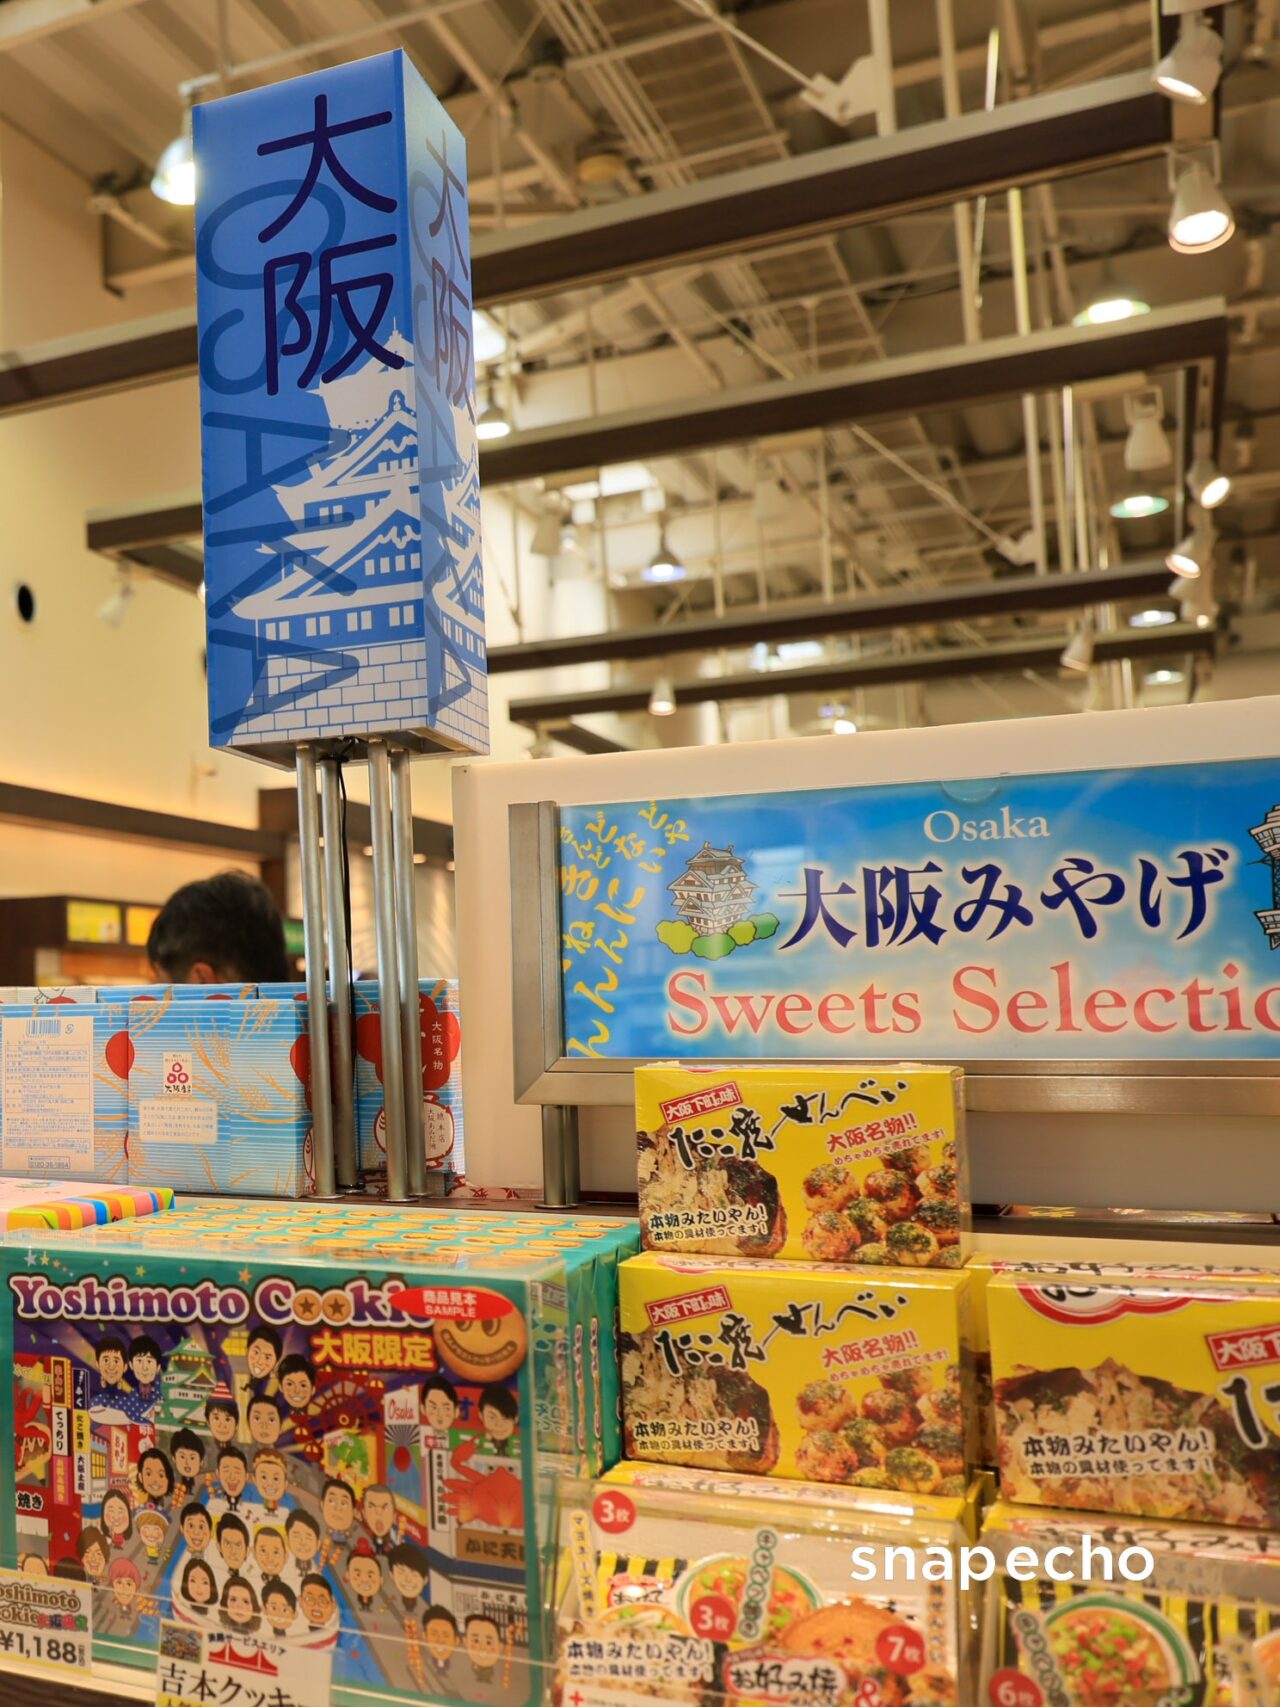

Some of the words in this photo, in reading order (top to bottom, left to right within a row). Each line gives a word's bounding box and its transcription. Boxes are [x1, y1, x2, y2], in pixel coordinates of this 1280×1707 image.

[257, 94, 405, 395] 大阪
[426, 129, 476, 424] 大阪
[196, 178, 361, 734] OSAKA
[923, 806, 1051, 843] Osaka
[777, 848, 1230, 950] 大阪みやげ
[668, 972, 922, 1036] Sweets
[432, 1021, 444, 1071] 大阪名物
[11, 1274, 249, 1323] Yoshimoto
[423, 1289, 478, 1306] 商品見本
[424, 1305, 478, 1318] SAMPLE
[313, 1331, 436, 1370] 大阪限定
[55, 1411, 64, 1451] てっちり
[388, 1399, 415, 1421] Osaka
[600, 1500, 630, 1524] 3枚
[0, 1629, 77, 1664] ¥1,188
[160, 1663, 306, 1707] 吉本クッキ
